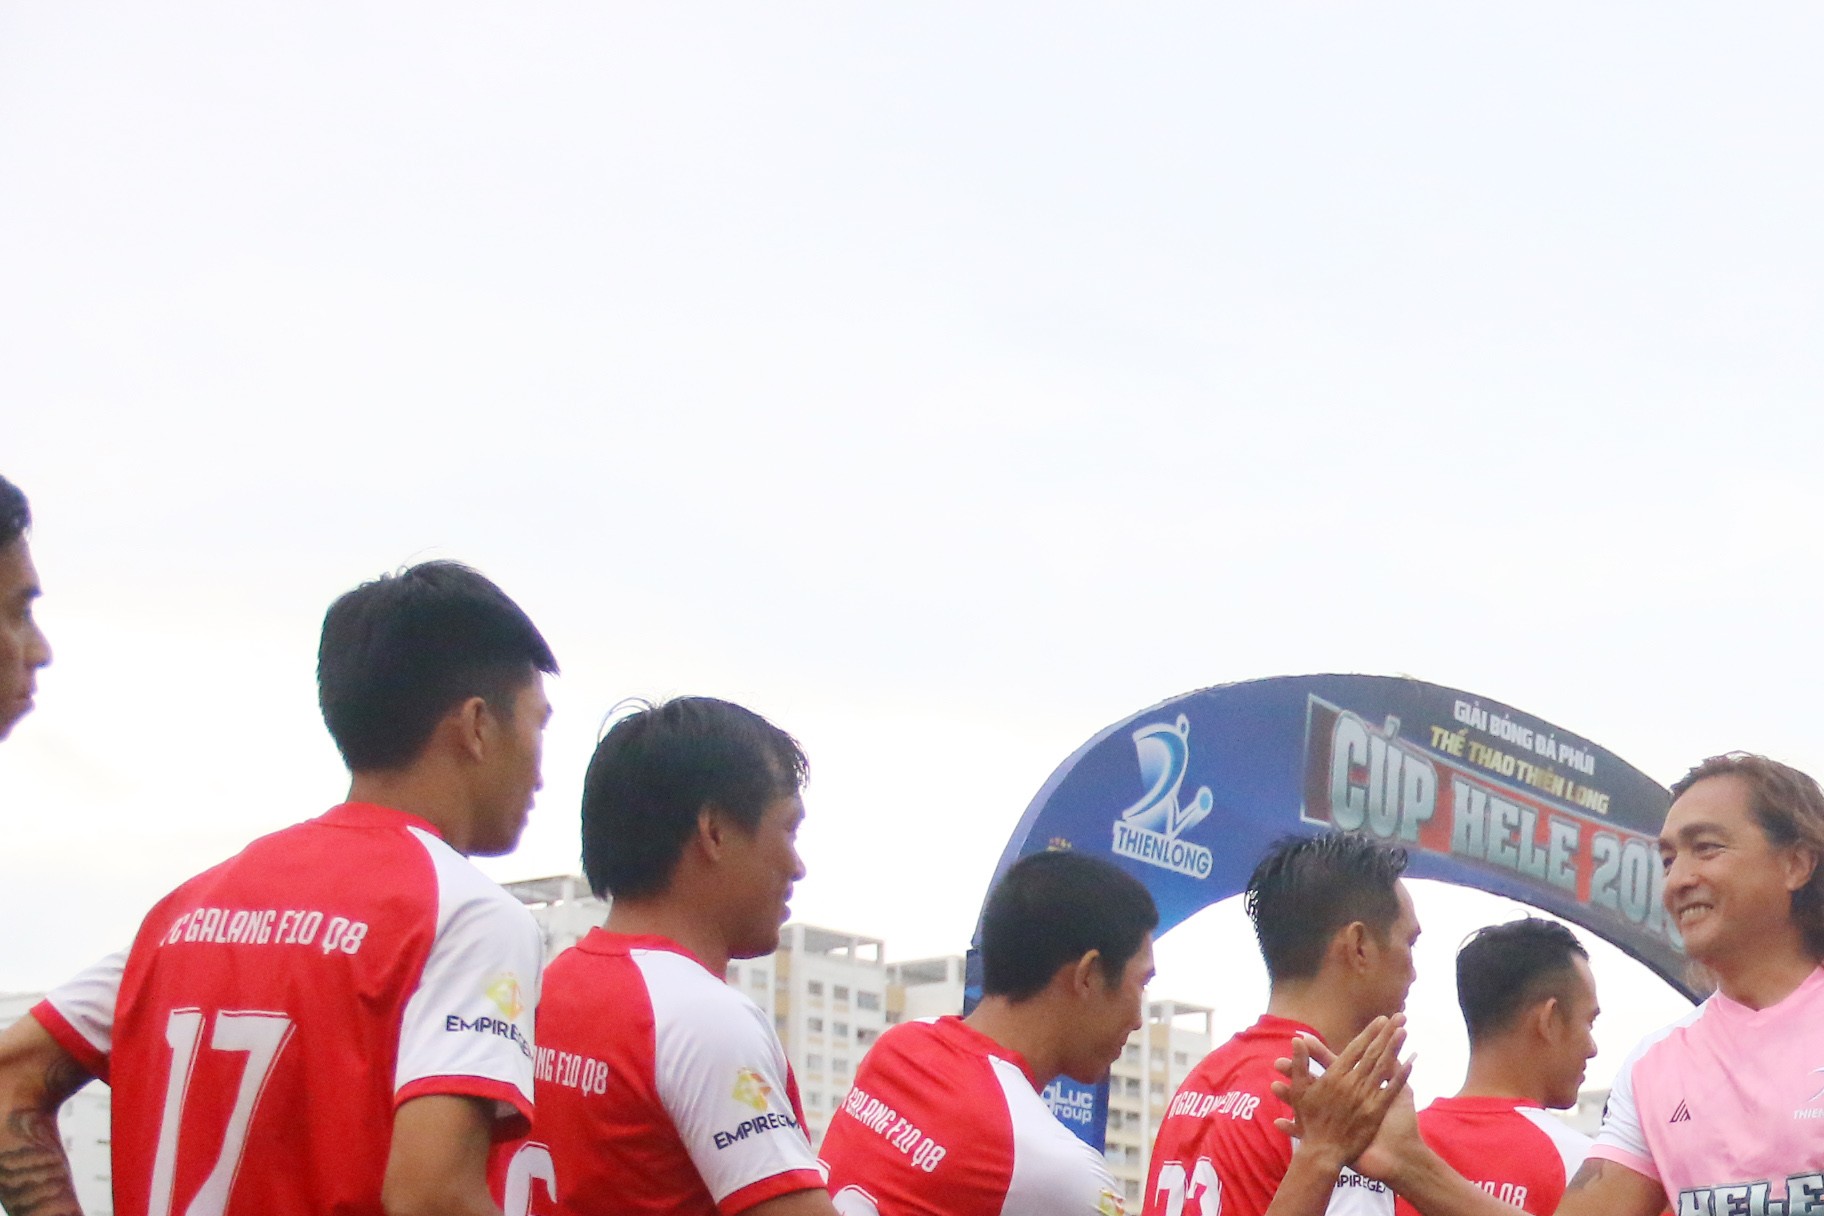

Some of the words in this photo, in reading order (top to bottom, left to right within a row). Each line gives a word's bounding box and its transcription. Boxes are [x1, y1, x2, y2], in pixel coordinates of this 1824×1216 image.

[1468, 741, 1515, 777] THAO
[1118, 826, 1211, 875] THIENLONG
[1330, 711, 1437, 842] CÚP
[1450, 775, 1579, 890] HELE
[1590, 833, 1685, 953] 201
[185, 908, 277, 944] GALANG
[275, 909, 324, 944] F10
[321, 915, 369, 955] Q8
[555, 1051, 583, 1089] F10
[581, 1057, 610, 1097] Q8
[885, 1116, 922, 1154] F10
[910, 1137, 948, 1173] Q8
